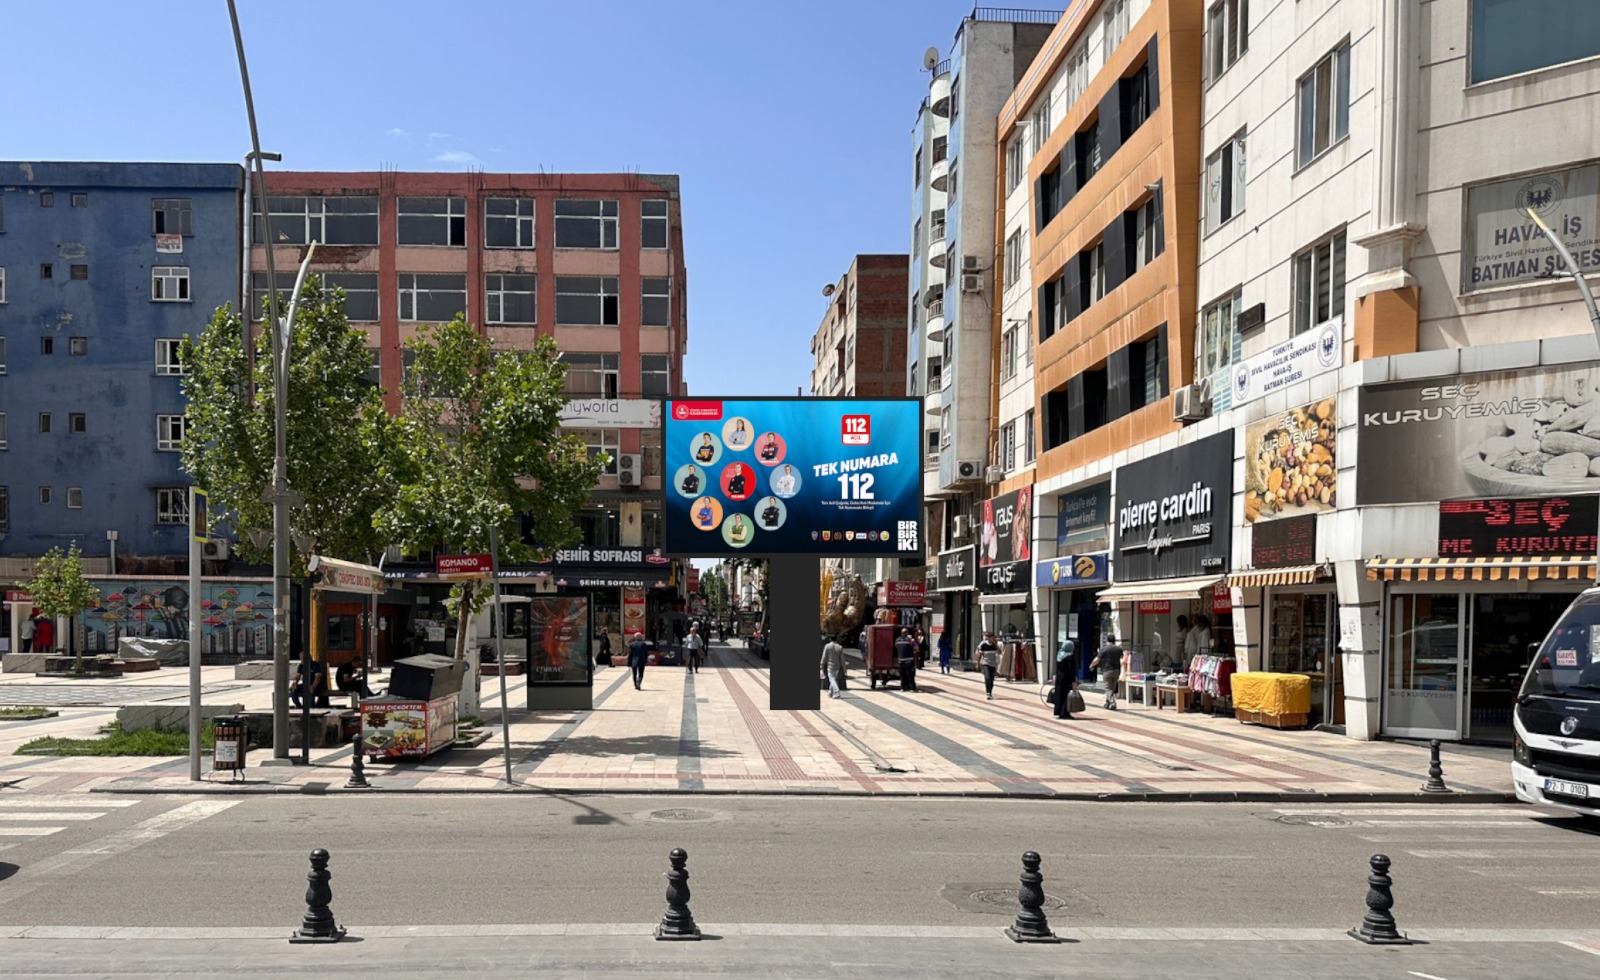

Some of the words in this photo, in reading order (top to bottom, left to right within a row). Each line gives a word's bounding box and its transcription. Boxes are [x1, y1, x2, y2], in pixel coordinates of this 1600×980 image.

[1494, 222, 1547, 246] HAVA
[1563, 214, 1582, 238] İŞ
[1473, 252, 1503, 264] Türkiye
[1505, 249, 1524, 258] Sivil
[1471, 257, 1540, 283] BATMAN
[1263, 355, 1289, 371] HAVACILIK
[1289, 342, 1317, 360] SENDİKASI
[1272, 341, 1294, 357] TÜRKİYE
[1263, 379, 1284, 392] BATMAN
[1420, 383, 1479, 401] SEÇ
[1364, 397, 1542, 427] KURUYEMİŞ
[845, 417, 867, 433] 112
[813, 462, 838, 477] TEK
[840, 452, 899, 472] NUMARA
[837, 472, 875, 500] 112
[995, 504, 1013, 531] rays
[1120, 499, 1157, 537] pierre
[1160, 481, 1211, 521] cardin
[1192, 522, 1211, 534] PARIS
[439, 557, 479, 568] KOMANDO
[555, 546, 590, 564] ŞEHİR
[593, 550, 642, 562] SOFRASI
[607, 579, 644, 587] SOFRASI
[987, 564, 1012, 589] rays
[1549, 781, 1557, 791] 72
[1560, 783, 1565, 792] D
[1570, 784, 1586, 796] 0102
